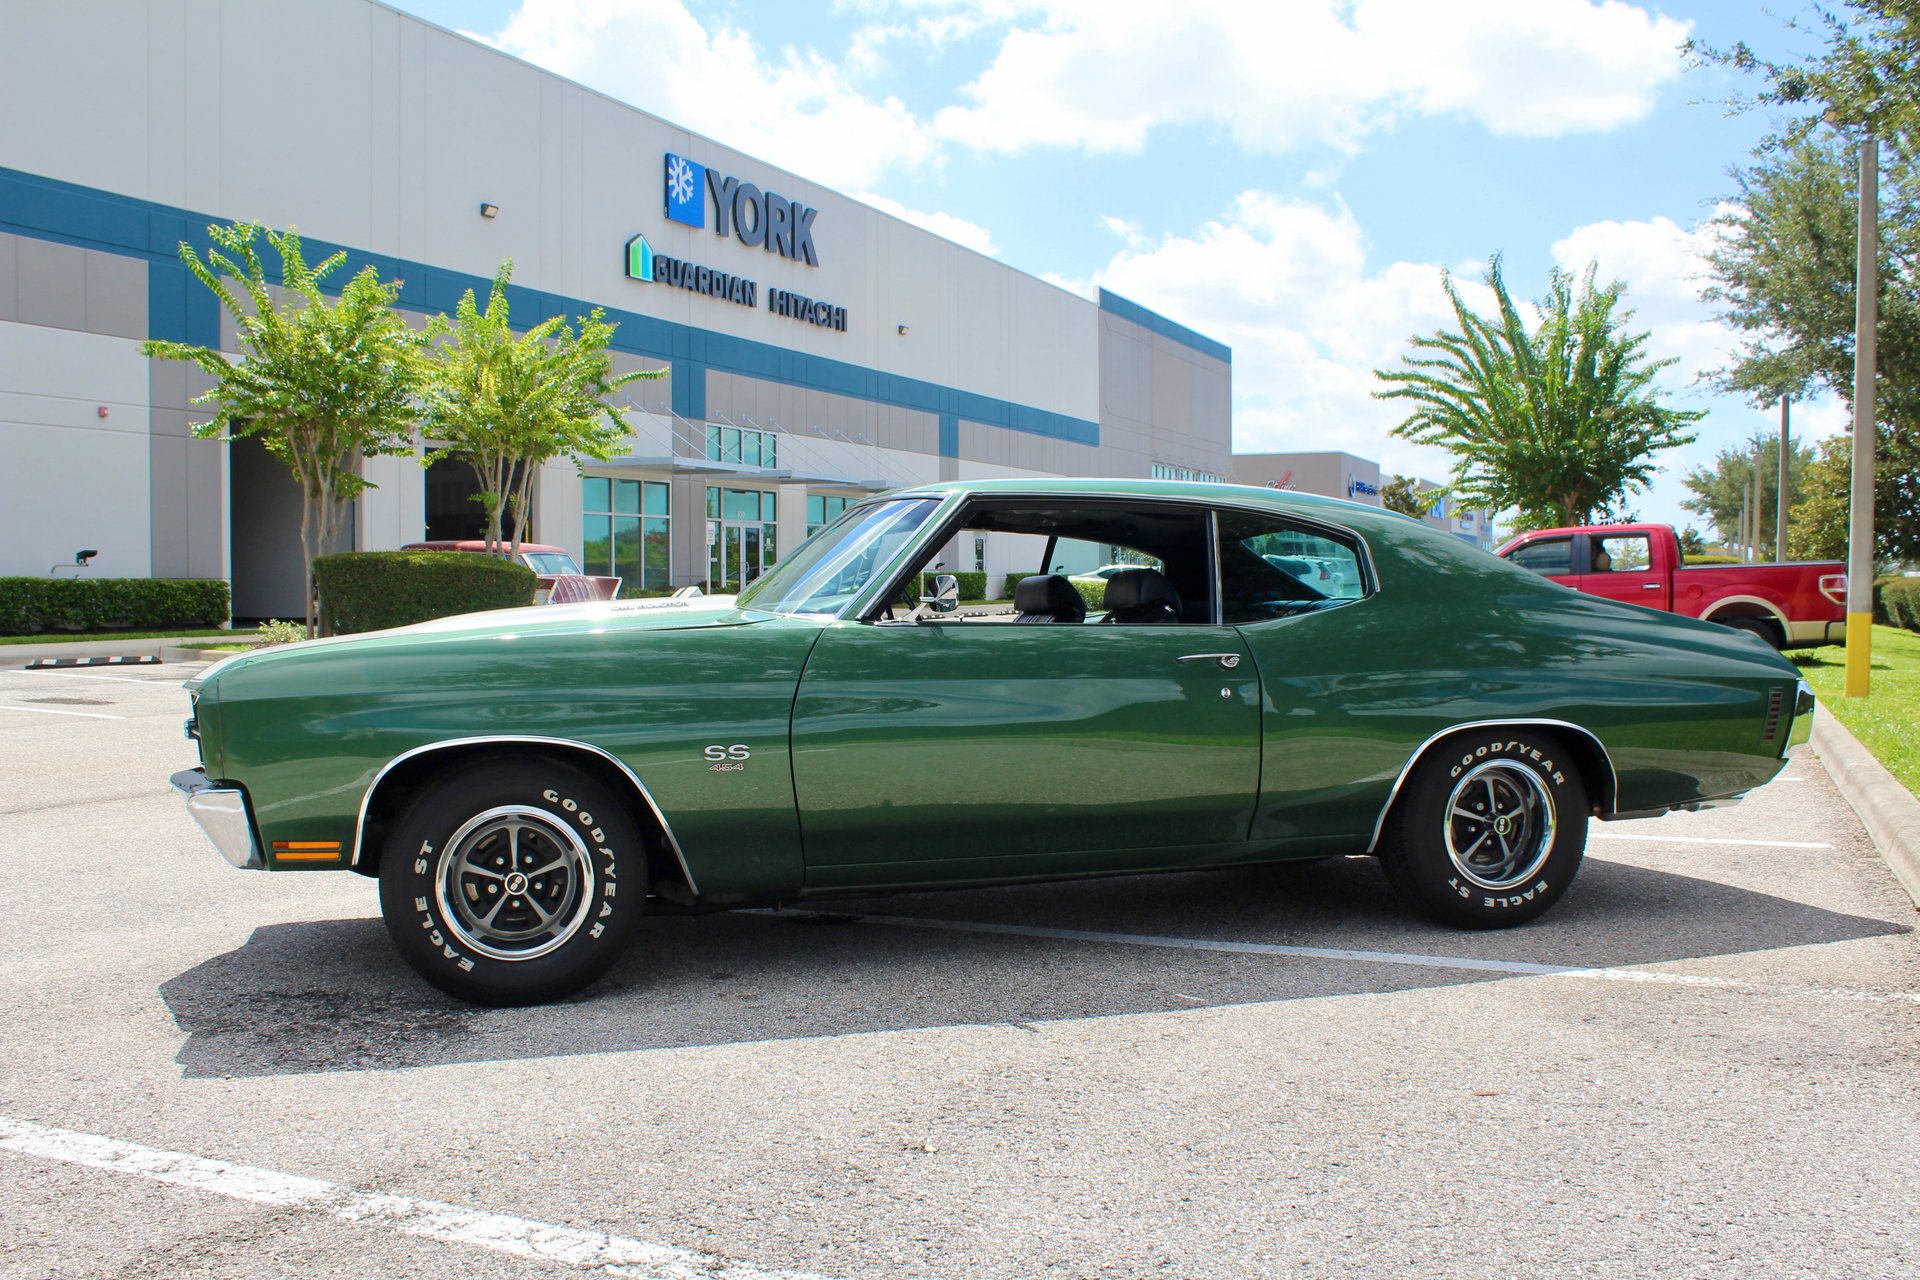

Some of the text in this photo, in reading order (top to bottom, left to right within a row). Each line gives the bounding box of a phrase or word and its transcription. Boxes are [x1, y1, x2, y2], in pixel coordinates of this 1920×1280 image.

[705, 168, 819, 267] YORK
[653, 254, 847, 332] GUARDIAN HITACHI
[703, 744, 751, 761] SS
[709, 762, 744, 771] 454
[1450, 741, 1565, 785] GOODYEAR
[542, 789, 616, 939] GOODYEAR
[1448, 877, 1548, 908] EAGLE ST
[414, 839, 475, 972] EAGLE ST
